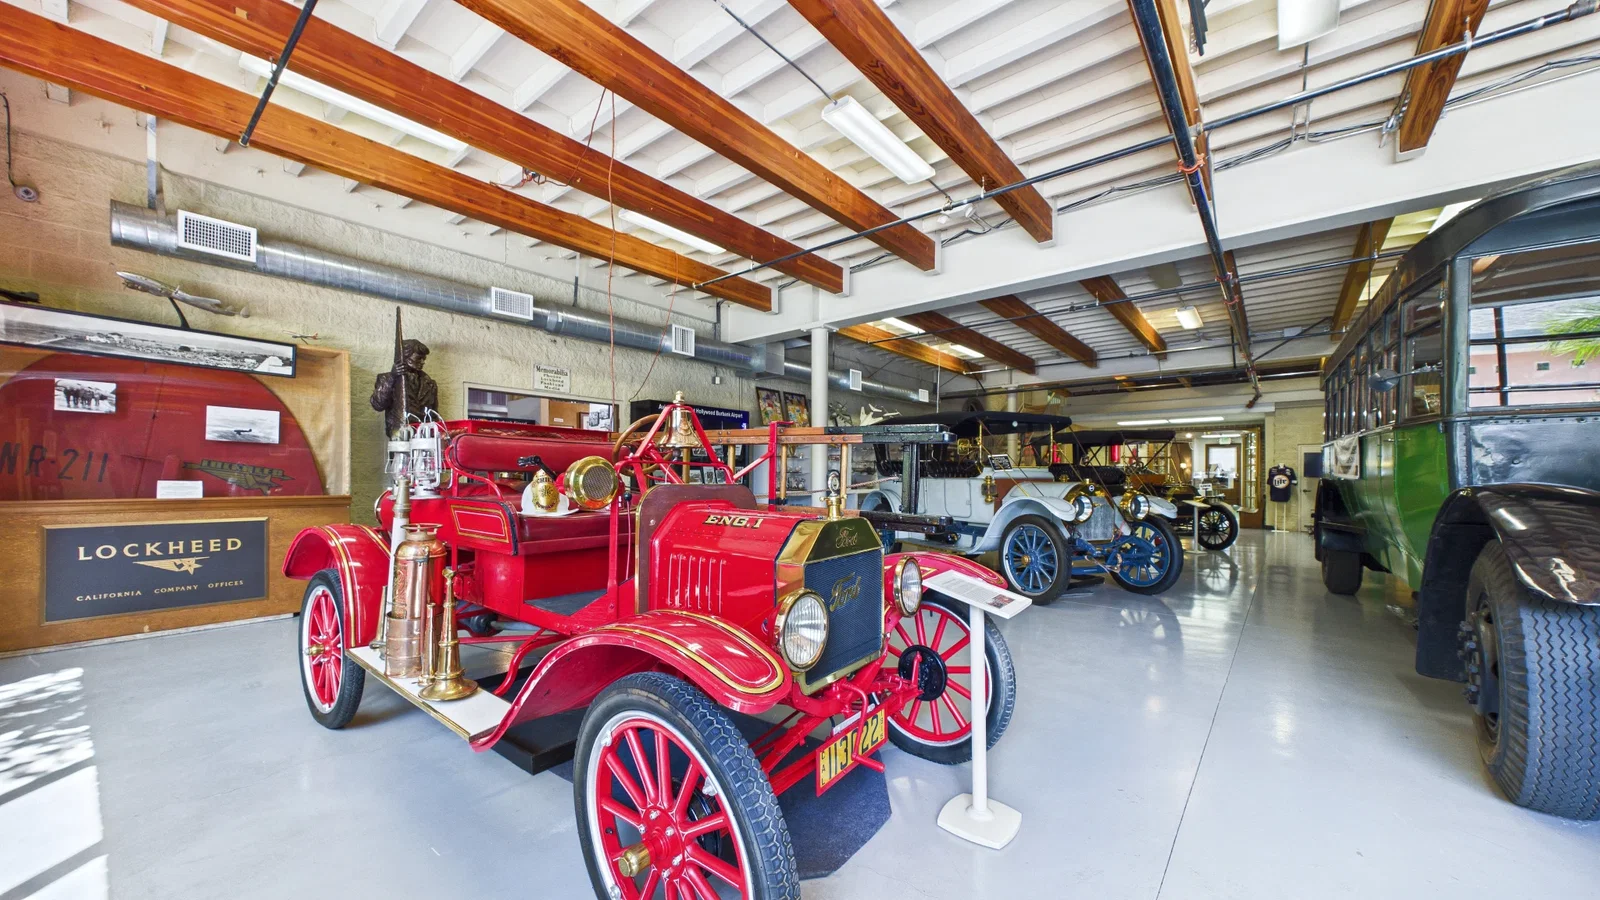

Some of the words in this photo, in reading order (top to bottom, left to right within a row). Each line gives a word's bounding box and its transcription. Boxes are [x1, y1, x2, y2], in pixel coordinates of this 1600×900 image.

[535, 365, 569, 377] Memorabilia
[695, 407, 716, 416] Hollywood
[835, 526, 858, 549] Ford
[78, 537, 242, 561] LOCKHEED
[76, 590, 142, 601] CALIFORNIA
[154, 584, 199, 594] COMPANY
[207, 580, 244, 589] OFFICES
[829, 571, 862, 612] Ford
